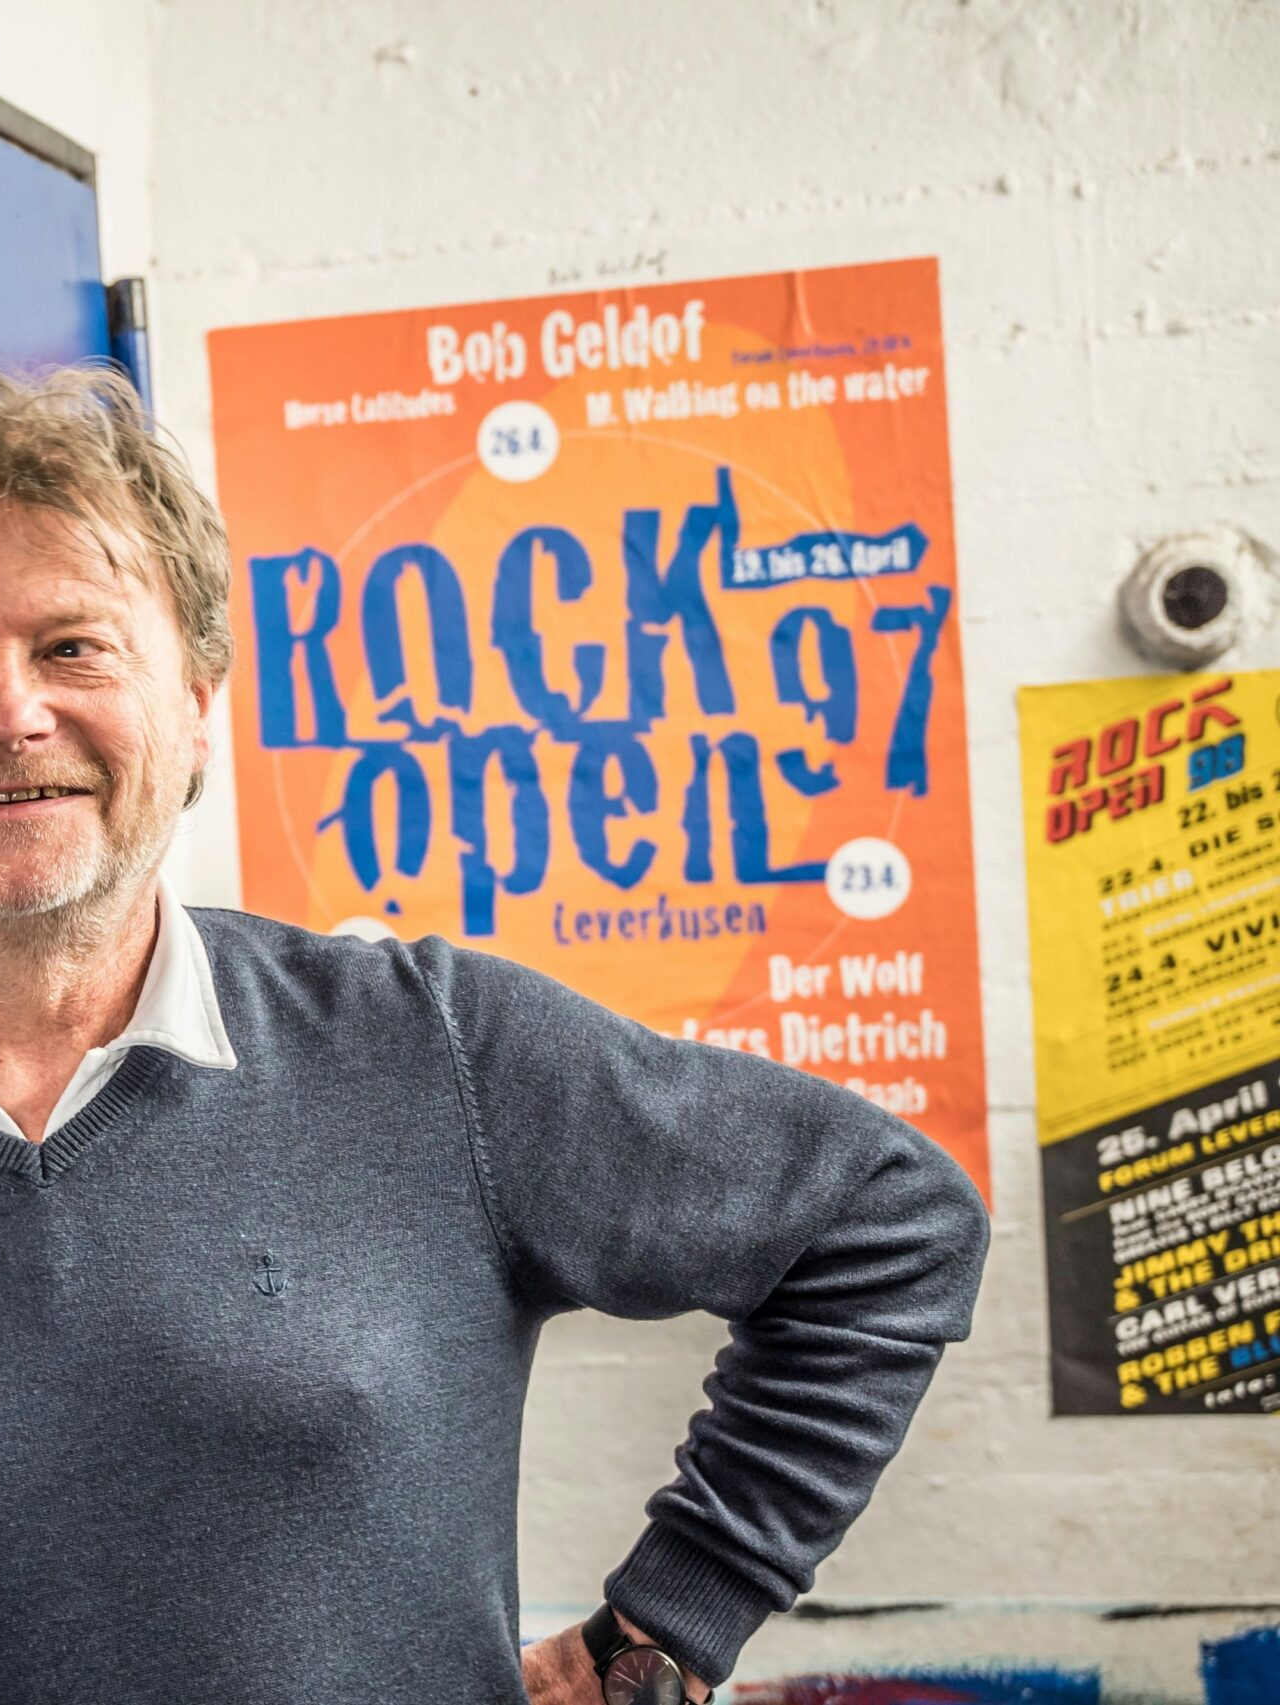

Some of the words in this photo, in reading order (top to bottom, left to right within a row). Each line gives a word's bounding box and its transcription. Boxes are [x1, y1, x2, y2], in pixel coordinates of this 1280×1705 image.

[427, 321, 527, 385] Bob
[541, 299, 705, 378] Geldof
[623, 380, 739, 423] Walking
[745, 382, 780, 409] on
[787, 371, 837, 409] the
[844, 363, 930, 402] water
[768, 547, 806, 580] bis
[852, 536, 910, 575] April
[249, 466, 740, 749] ROCK
[769, 586, 952, 798] 97
[1048, 678, 1241, 795] ROCK
[1046, 764, 1164, 844] OPEN
[1188, 732, 1245, 791] 98
[1226, 783, 1264, 811] bis
[1189, 828, 1242, 858] DIE
[769, 954, 831, 1002] Der
[839, 951, 923, 998] Wolf
[780, 1009, 947, 1066] Dietrich
[1168, 1080, 1269, 1141] April
[1099, 1142, 1195, 1192] FORUM
[1109, 1177, 1193, 1225] NINE
[1114, 1230, 1230, 1289] JIMMY
[1149, 1258, 1213, 1299] THE
[1115, 1295, 1206, 1340] CARL
[1117, 1319, 1256, 1384] ROBBEN
[1154, 1355, 1221, 1395] THE
